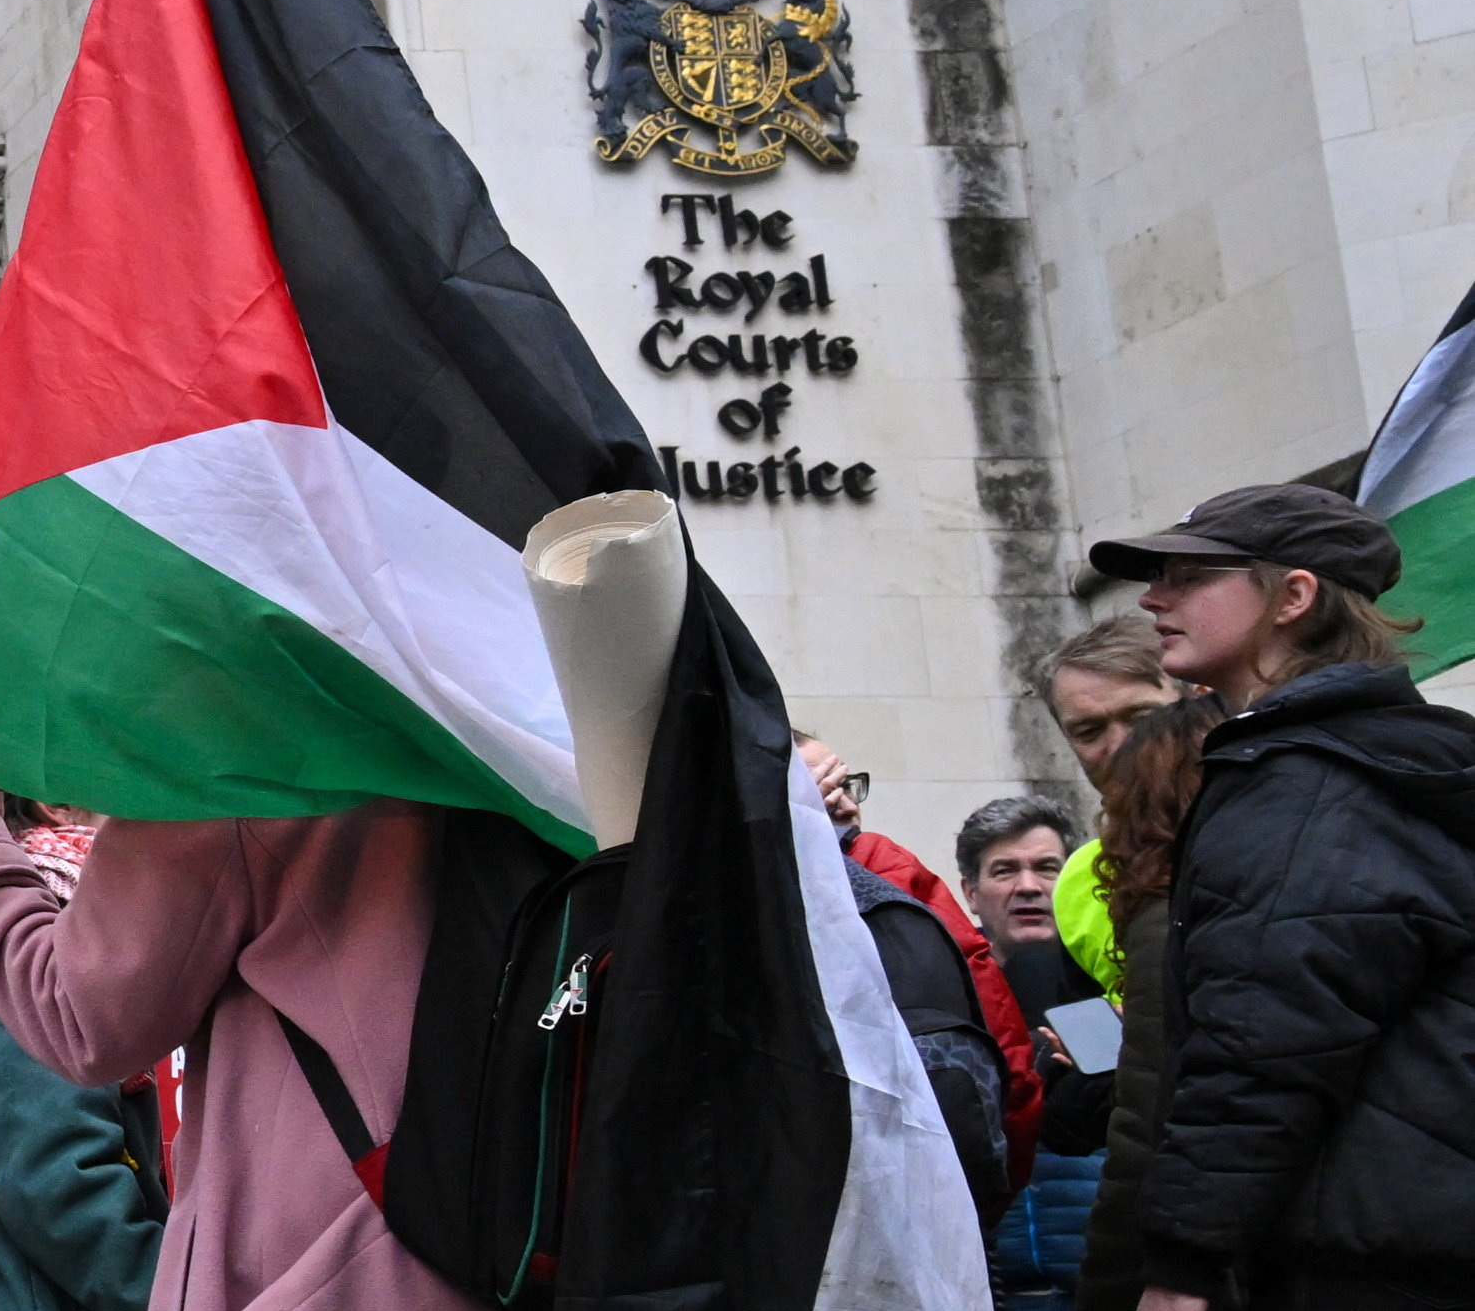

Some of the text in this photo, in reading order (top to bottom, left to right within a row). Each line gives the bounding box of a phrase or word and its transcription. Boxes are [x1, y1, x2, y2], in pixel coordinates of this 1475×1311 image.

[774, 112, 834, 156] DROIT
[661, 193, 794, 250] The
[644, 254, 834, 324] Royal
[639, 319, 857, 374] Courts
[717, 382, 791, 442] of
[658, 446, 878, 500] Justice
